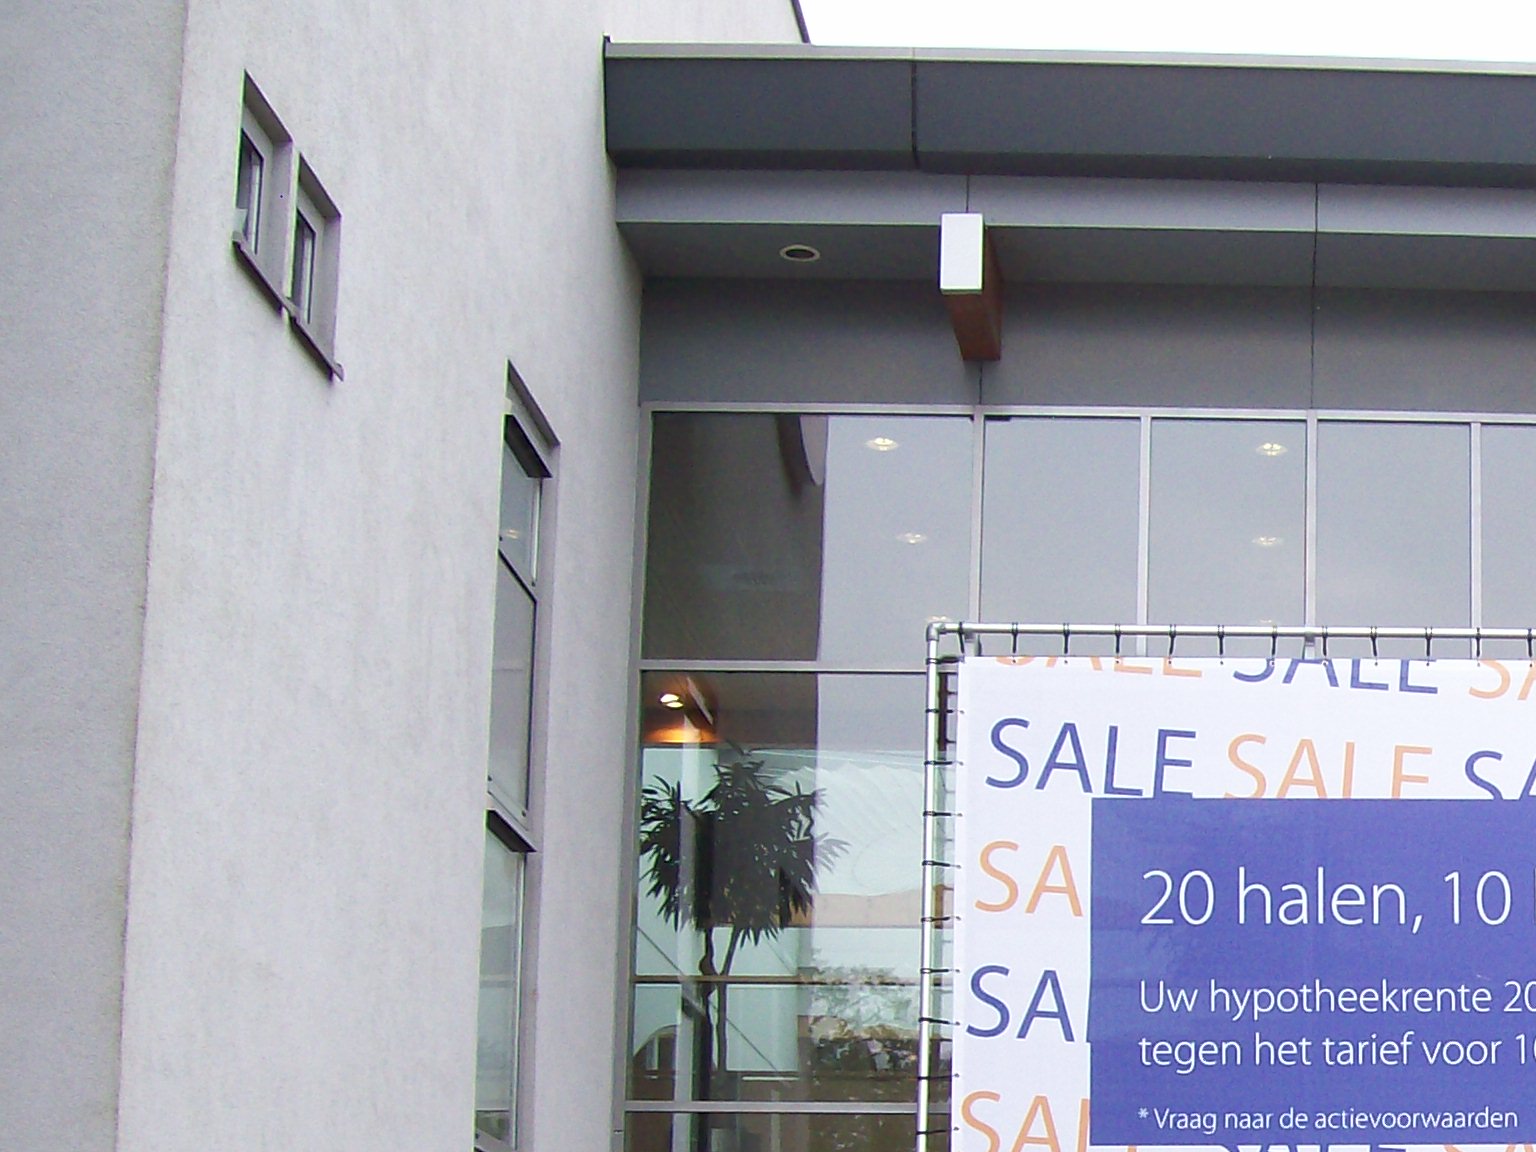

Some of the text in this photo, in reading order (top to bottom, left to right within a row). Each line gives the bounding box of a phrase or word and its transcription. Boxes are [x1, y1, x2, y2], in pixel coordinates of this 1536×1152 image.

[985, 718, 1197, 798] SALE
[1225, 733, 1433, 799] SALE
[1140, 869, 1215, 926] 20
[1238, 866, 1423, 935] halen,
[1444, 870, 1512, 926] 10
[966, 964, 1088, 1043] SA
[1140, 979, 1198, 1013] Uw
[1210, 978, 1493, 1022] hypotheekrente
[1138, 1036, 1241, 1075] tegen
[1255, 1031, 1313, 1066] het
[1321, 1030, 1415, 1066] tarief
[1421, 1038, 1503, 1066] voor
[1153, 1107, 1217, 1135] Vraag
[1224, 1111, 1274, 1130] naar
[1279, 1106, 1309, 1130] de
[1314, 1105, 1519, 1130] actievoorwaarden
